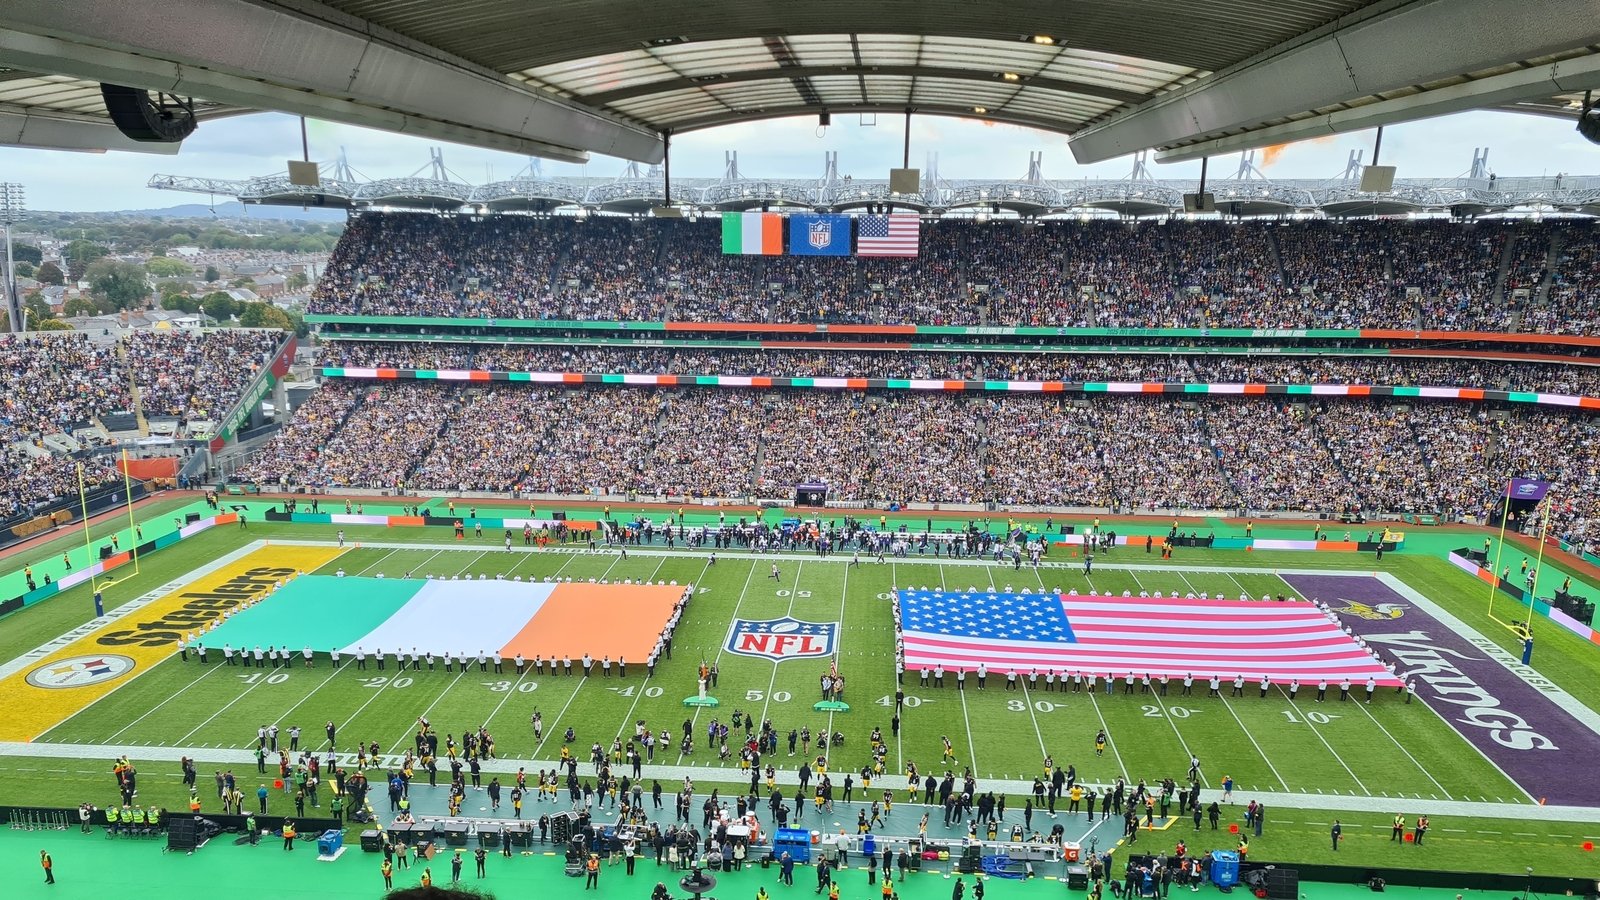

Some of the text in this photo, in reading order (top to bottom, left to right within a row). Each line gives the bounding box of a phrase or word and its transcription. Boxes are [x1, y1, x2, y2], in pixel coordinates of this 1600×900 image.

[812, 232, 828, 244] NFL
[96, 567, 297, 648] Steelers
[25, 582, 183, 658] IT TAKES ALL OF US
[738, 633, 823, 656] NFL
[1469, 638, 1562, 693] END RACISM
[241, 672, 290, 685] 10
[363, 676, 414, 689] 20
[489, 681, 539, 693] 30
[617, 685, 664, 698] 40
[744, 690, 792, 702] 50
[875, 695, 922, 708] 40
[1006, 700, 1055, 713] 30
[1140, 704, 1191, 718] 20
[1280, 710, 1330, 724] 10
[1068, 850, 1076, 858] G
